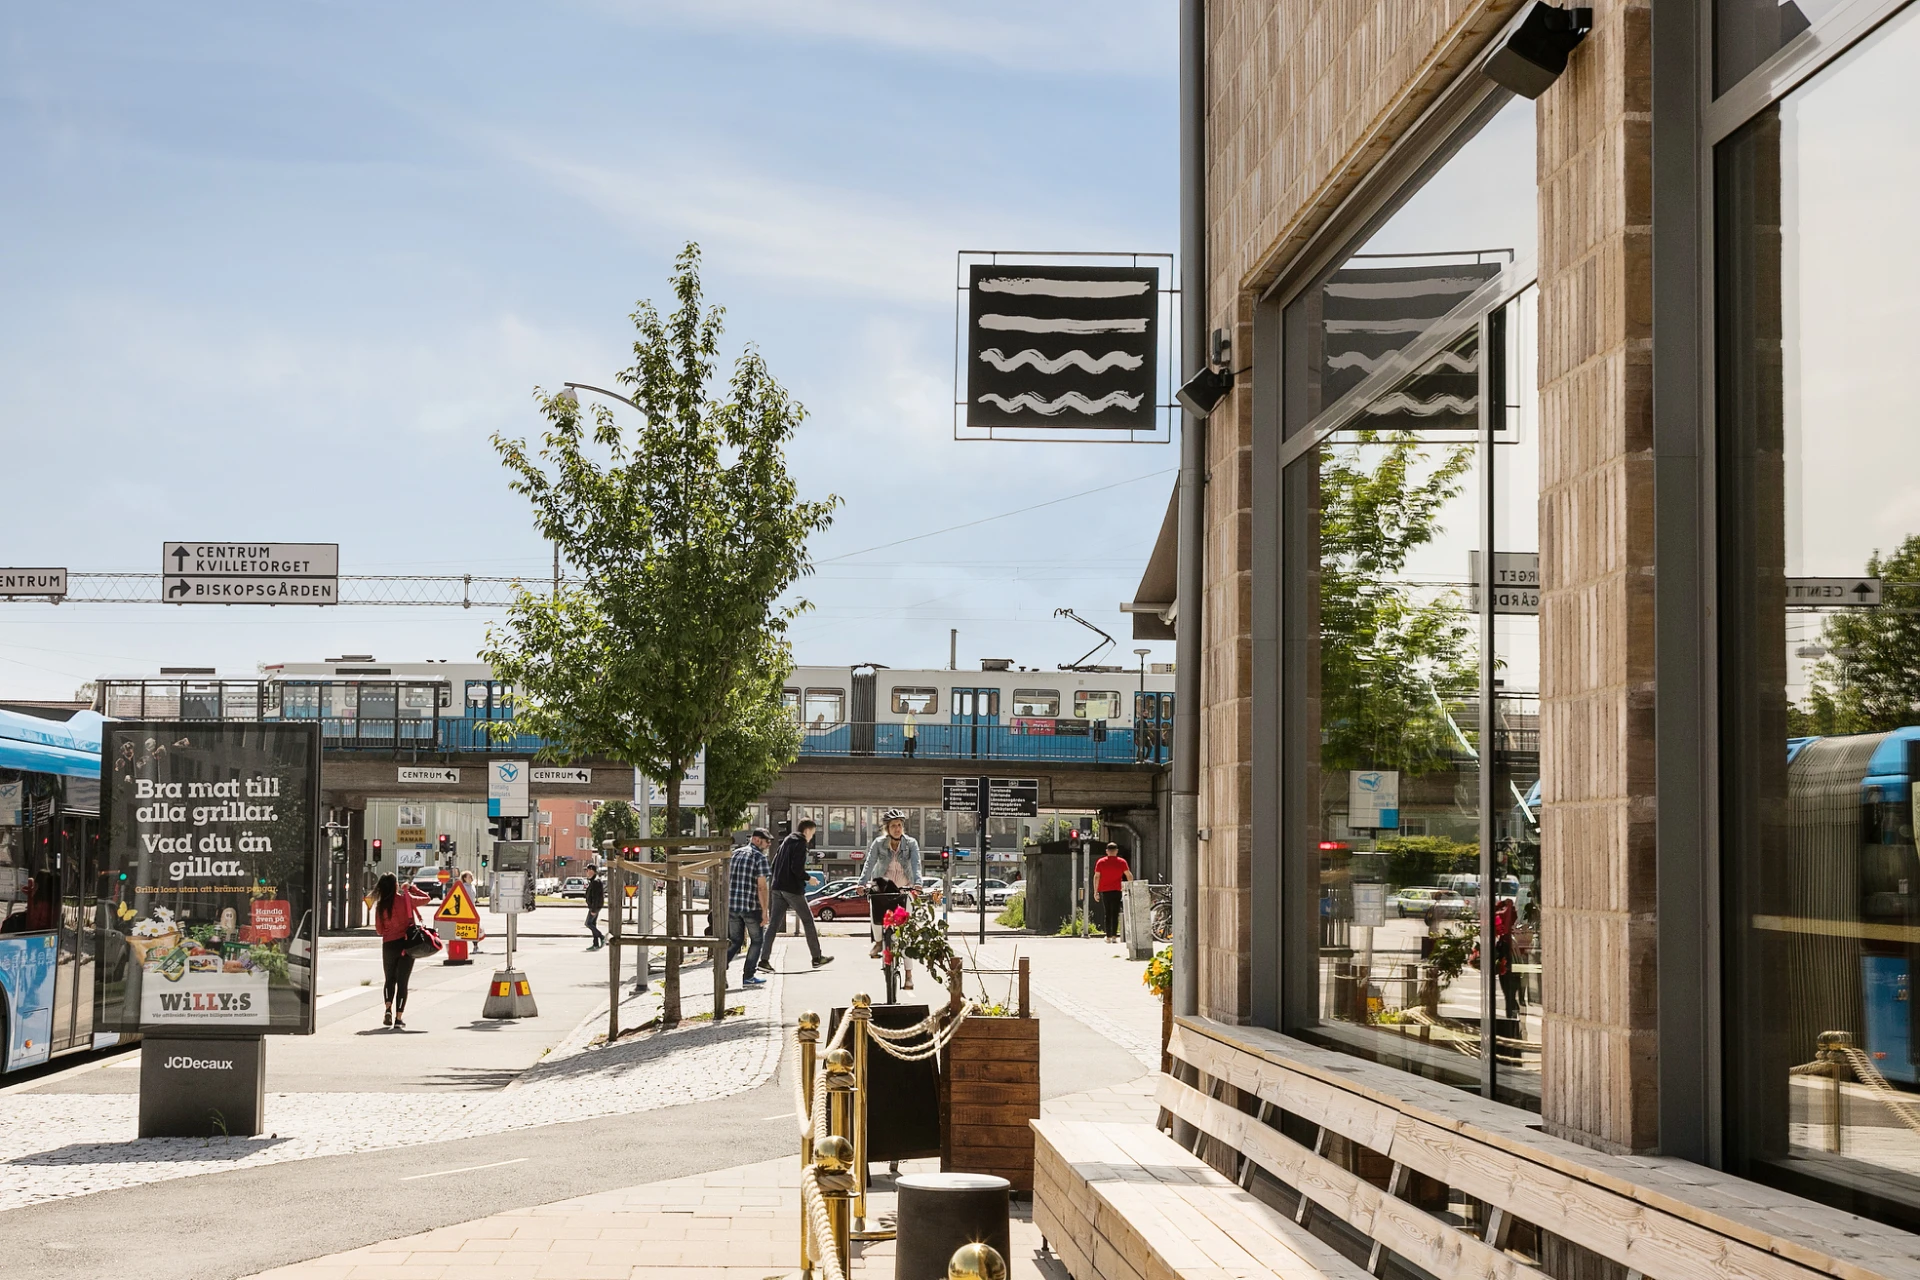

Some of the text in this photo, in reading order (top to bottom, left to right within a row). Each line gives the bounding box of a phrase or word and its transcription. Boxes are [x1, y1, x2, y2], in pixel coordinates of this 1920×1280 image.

[196, 546, 270, 558] CENTRUM
[196, 560, 310, 572] KVILLETORGET
[196, 581, 331, 596] BISKOPSGÅRDEN
[402, 771, 442, 779] CENTRUM
[533, 771, 574, 779] CENTRUM
[135, 775, 280, 799] Bra mat till
[136, 800, 279, 826] alla grillar.
[141, 831, 273, 854] Vad du än
[169, 855, 245, 881] gillar.
[135, 885, 160, 894] Grilla
[160, 886, 178, 894] loss
[178, 885, 199, 893] utan
[200, 885, 212, 893] att
[213, 884, 245, 893] bränna
[274, 915, 285, 923] på
[160, 992, 252, 1011] WiLLY:S
[164, 1056, 233, 1070] JCDecaux
